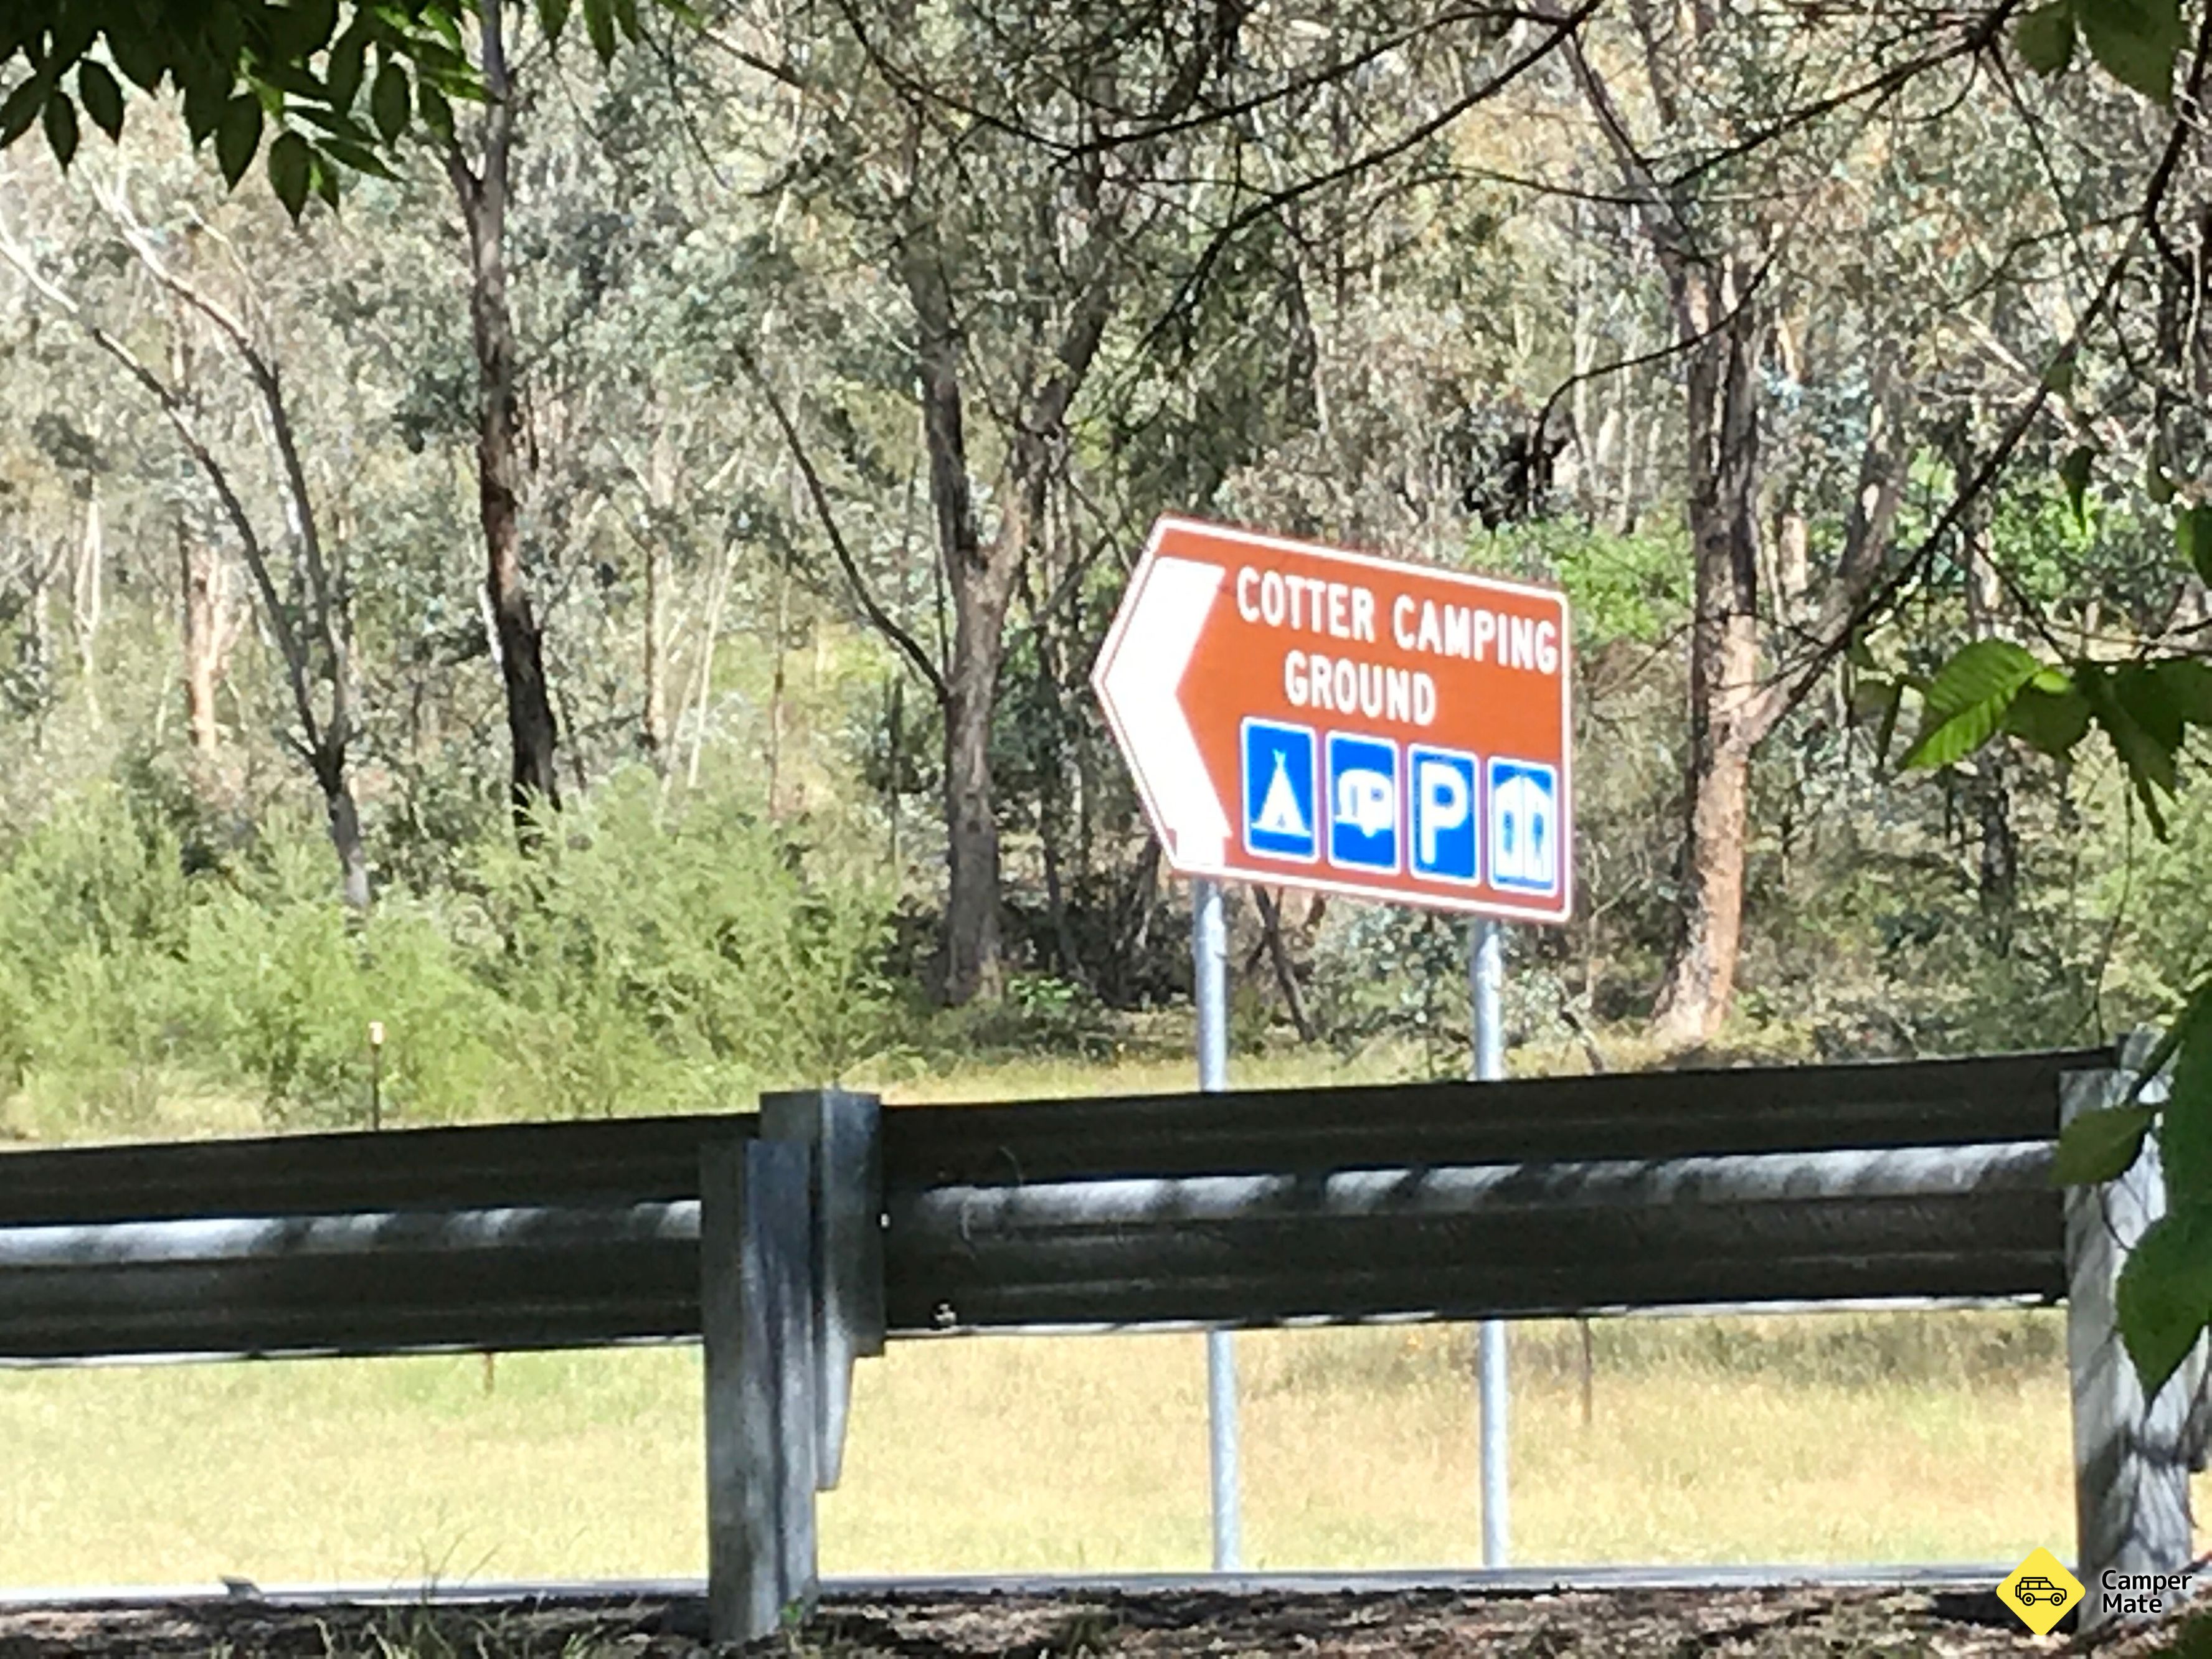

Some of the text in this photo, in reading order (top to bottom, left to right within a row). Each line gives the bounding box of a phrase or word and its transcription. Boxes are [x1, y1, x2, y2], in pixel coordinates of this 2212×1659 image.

[1237, 566, 1557, 674] COTTER CAMPING
[1284, 650, 1436, 726] GROUND
[1420, 760, 1468, 864] P
